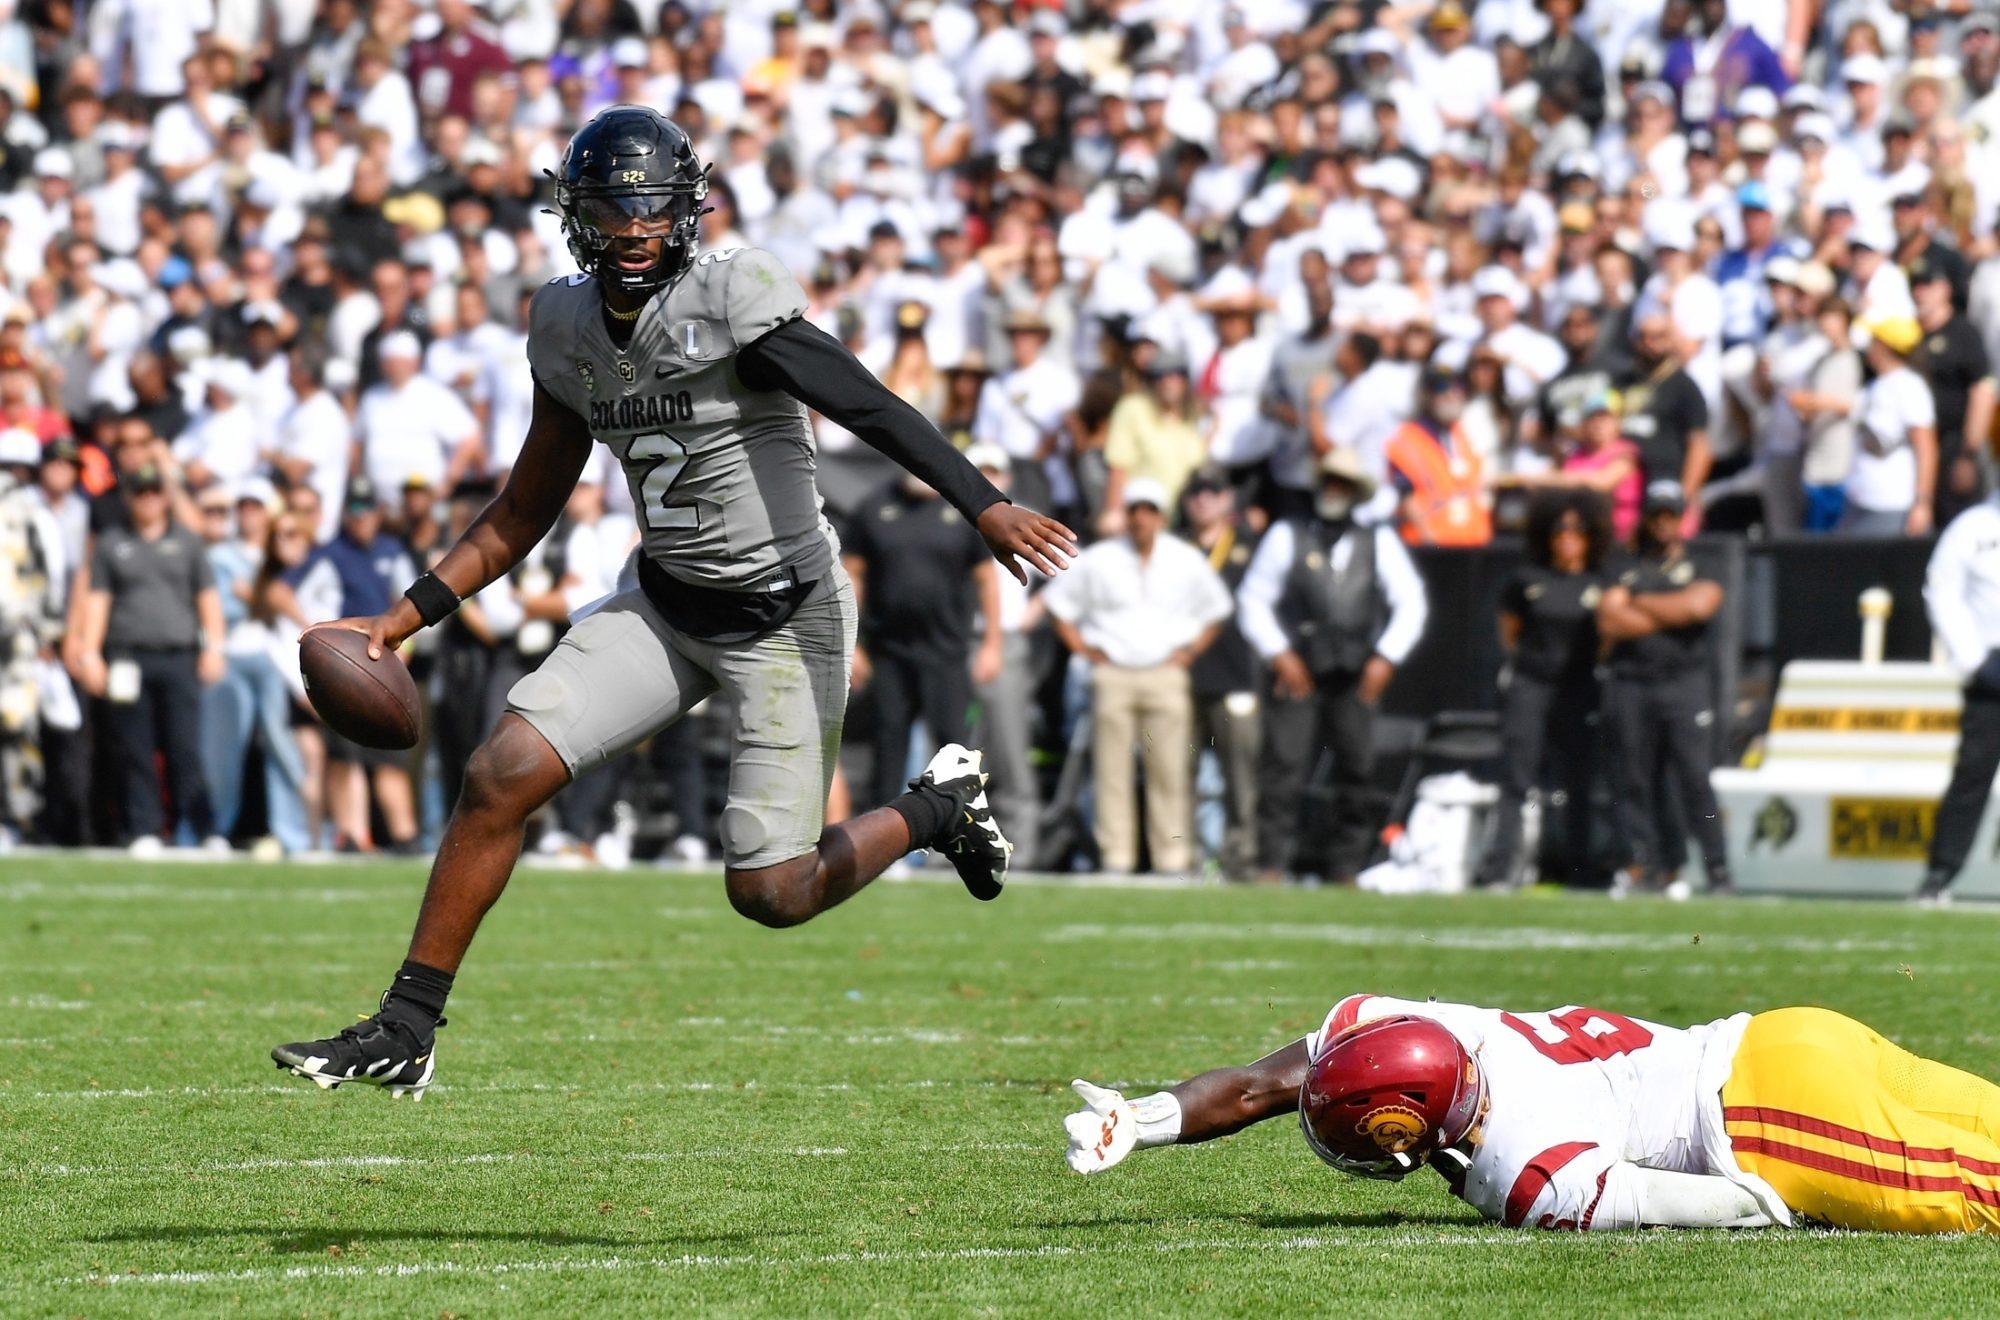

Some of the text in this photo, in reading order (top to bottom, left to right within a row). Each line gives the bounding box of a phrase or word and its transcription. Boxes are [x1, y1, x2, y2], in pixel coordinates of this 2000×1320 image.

[686, 324, 699, 354] L
[618, 361, 636, 383] CU
[590, 390, 693, 431] COLORADO
[624, 429, 701, 532] 2
